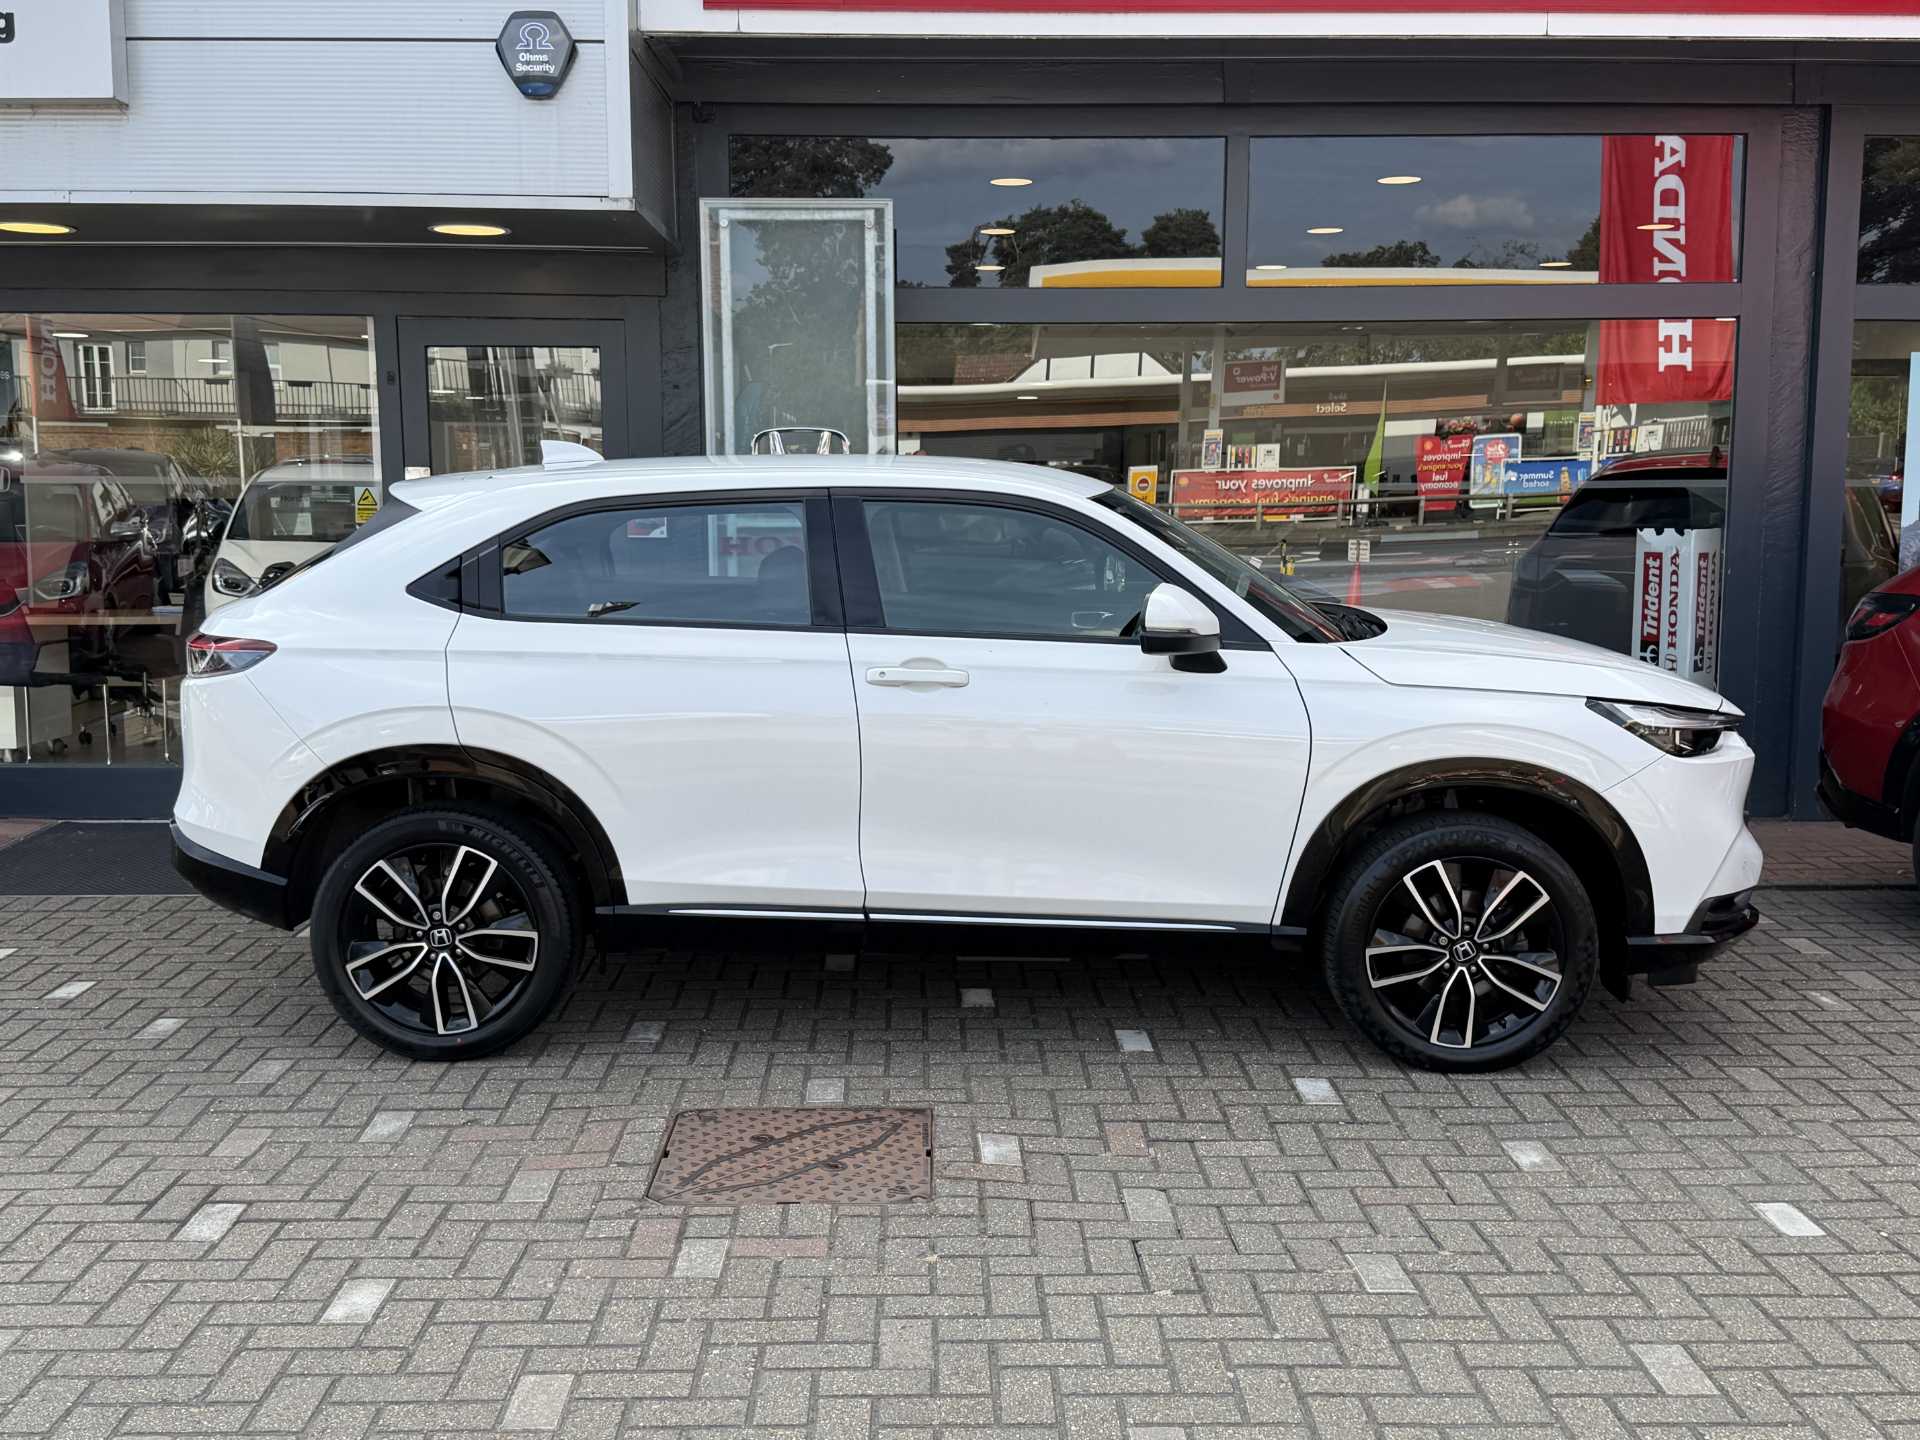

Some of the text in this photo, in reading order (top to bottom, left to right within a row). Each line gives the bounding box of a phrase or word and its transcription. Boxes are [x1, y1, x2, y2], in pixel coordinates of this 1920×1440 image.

[515, 63, 556, 73] Security
[518, 52, 549, 61] Ohms
[1643, 557, 1661, 637] Trident
[1667, 546, 1680, 649] HONDA
[1695, 559, 1709, 640] Trident
